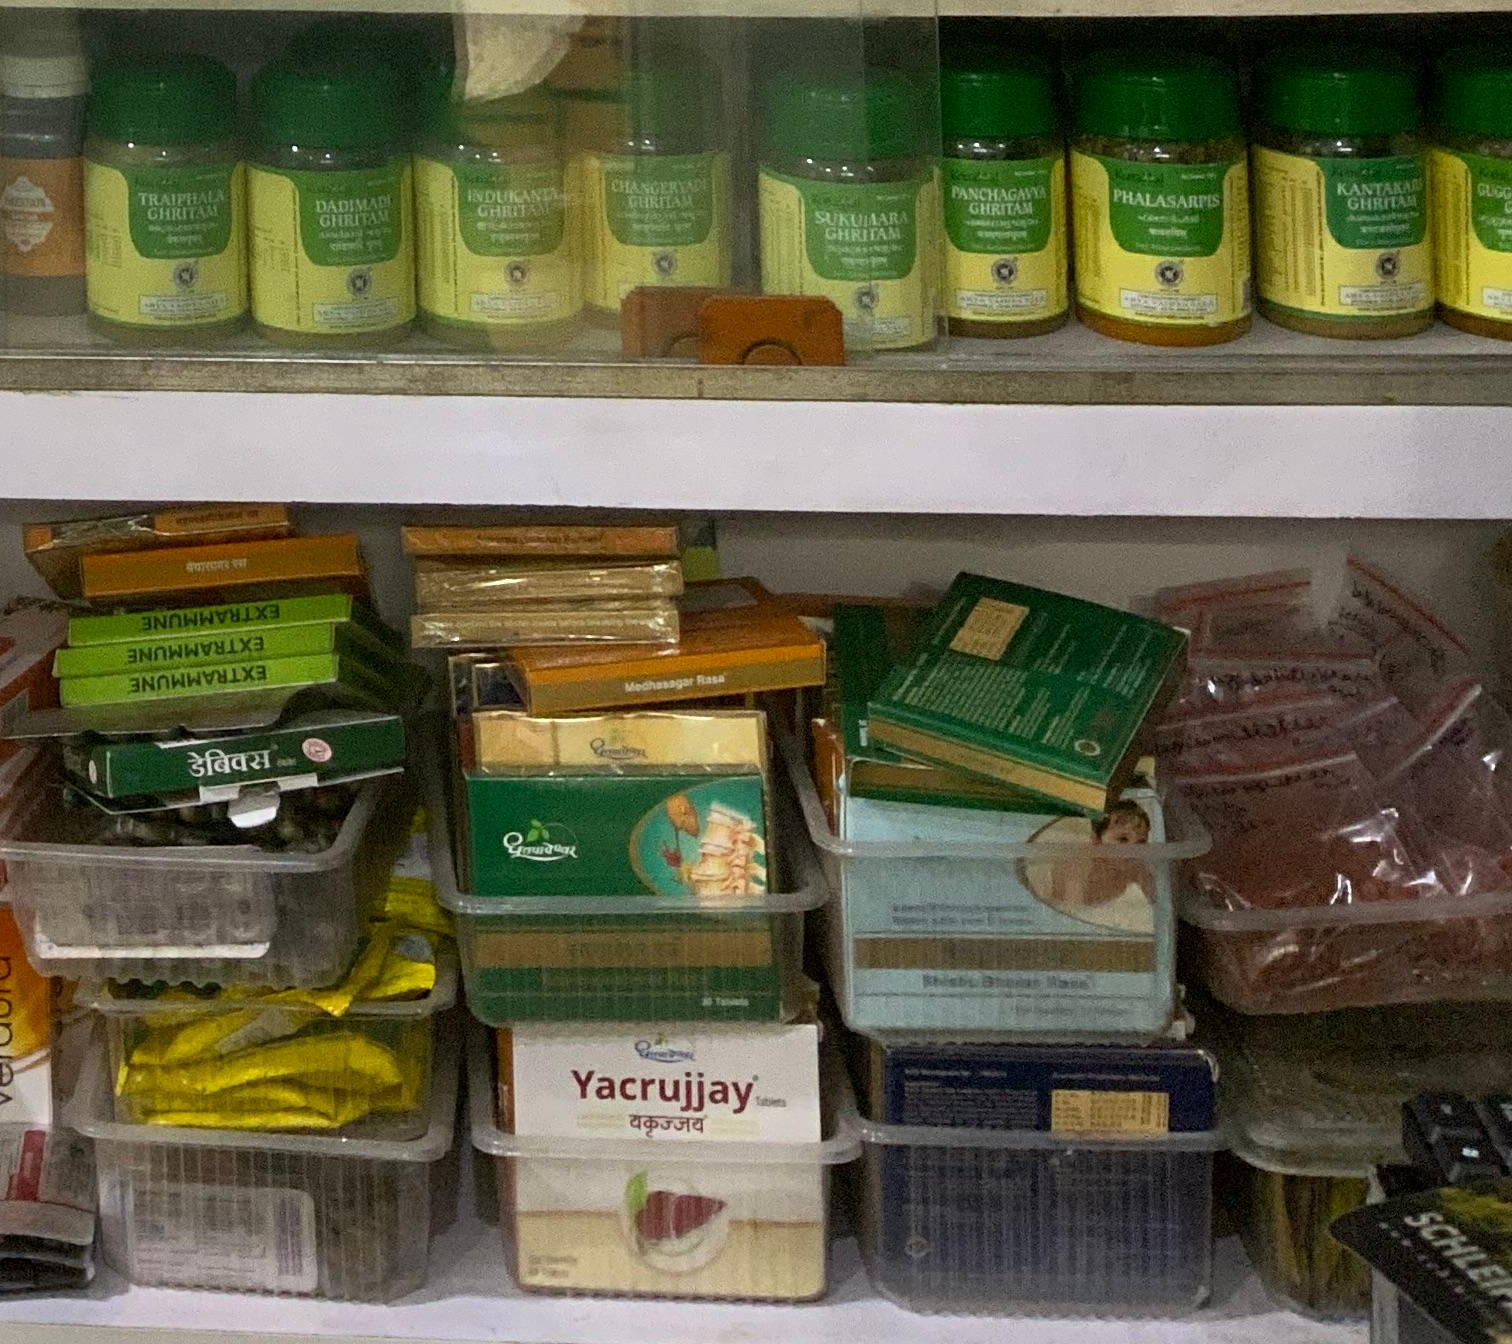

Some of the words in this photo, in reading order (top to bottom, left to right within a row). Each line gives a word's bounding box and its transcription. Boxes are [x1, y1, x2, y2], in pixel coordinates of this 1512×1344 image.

[137, 191, 225, 207] TRAIPHALA
[951, 185, 1047, 202] PANCHAGAVYA
[1112, 189, 1221, 209] PHALASARPIS
[1346, 194, 1418, 210] GHRITAM
[146, 205, 219, 221] GHRITAM
[315, 196, 392, 214] DADIMADI
[968, 201, 1034, 216] GHRITAM
[318, 211, 389, 228] GHRITAM
[814, 210, 908, 228] SUKUMARA
[824, 225, 902, 242] GHRITAM
[141, 603, 281, 632] EXTRAMMUNE
[126, 636, 265, 664] EXTRAMMUNE
[128, 664, 268, 694] EXTRAMMUNE
[623, 677, 694, 694] Medhasagar
[696, 673, 726, 687] Rasa
[571, 1068, 755, 1115] Yacrujjay
[629, 1113, 706, 1139] यकृज्जय
